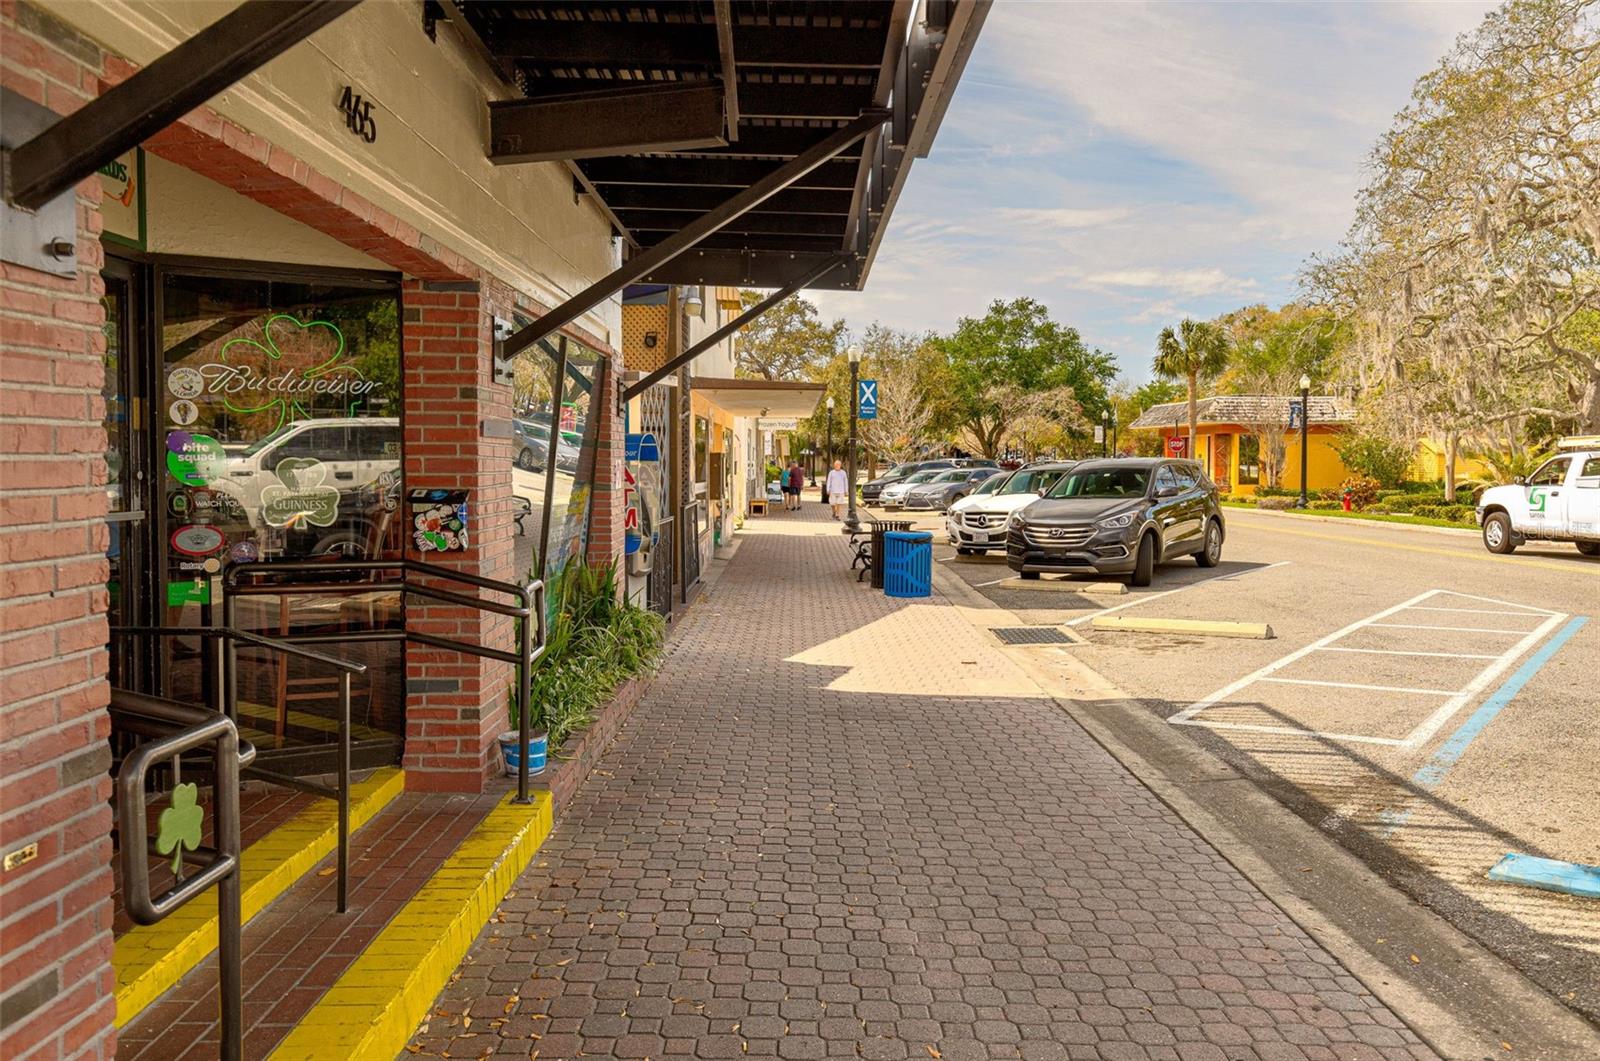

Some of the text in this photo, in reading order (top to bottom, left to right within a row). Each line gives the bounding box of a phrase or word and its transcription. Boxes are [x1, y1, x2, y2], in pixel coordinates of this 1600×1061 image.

[338, 85, 377, 144] 465
[199, 363, 383, 394] Budweiser
[182, 442, 209, 452] bite
[177, 451, 216, 464] squad
[273, 498, 328, 510] GUINNESS
[180, 561, 205, 571] Rotary
